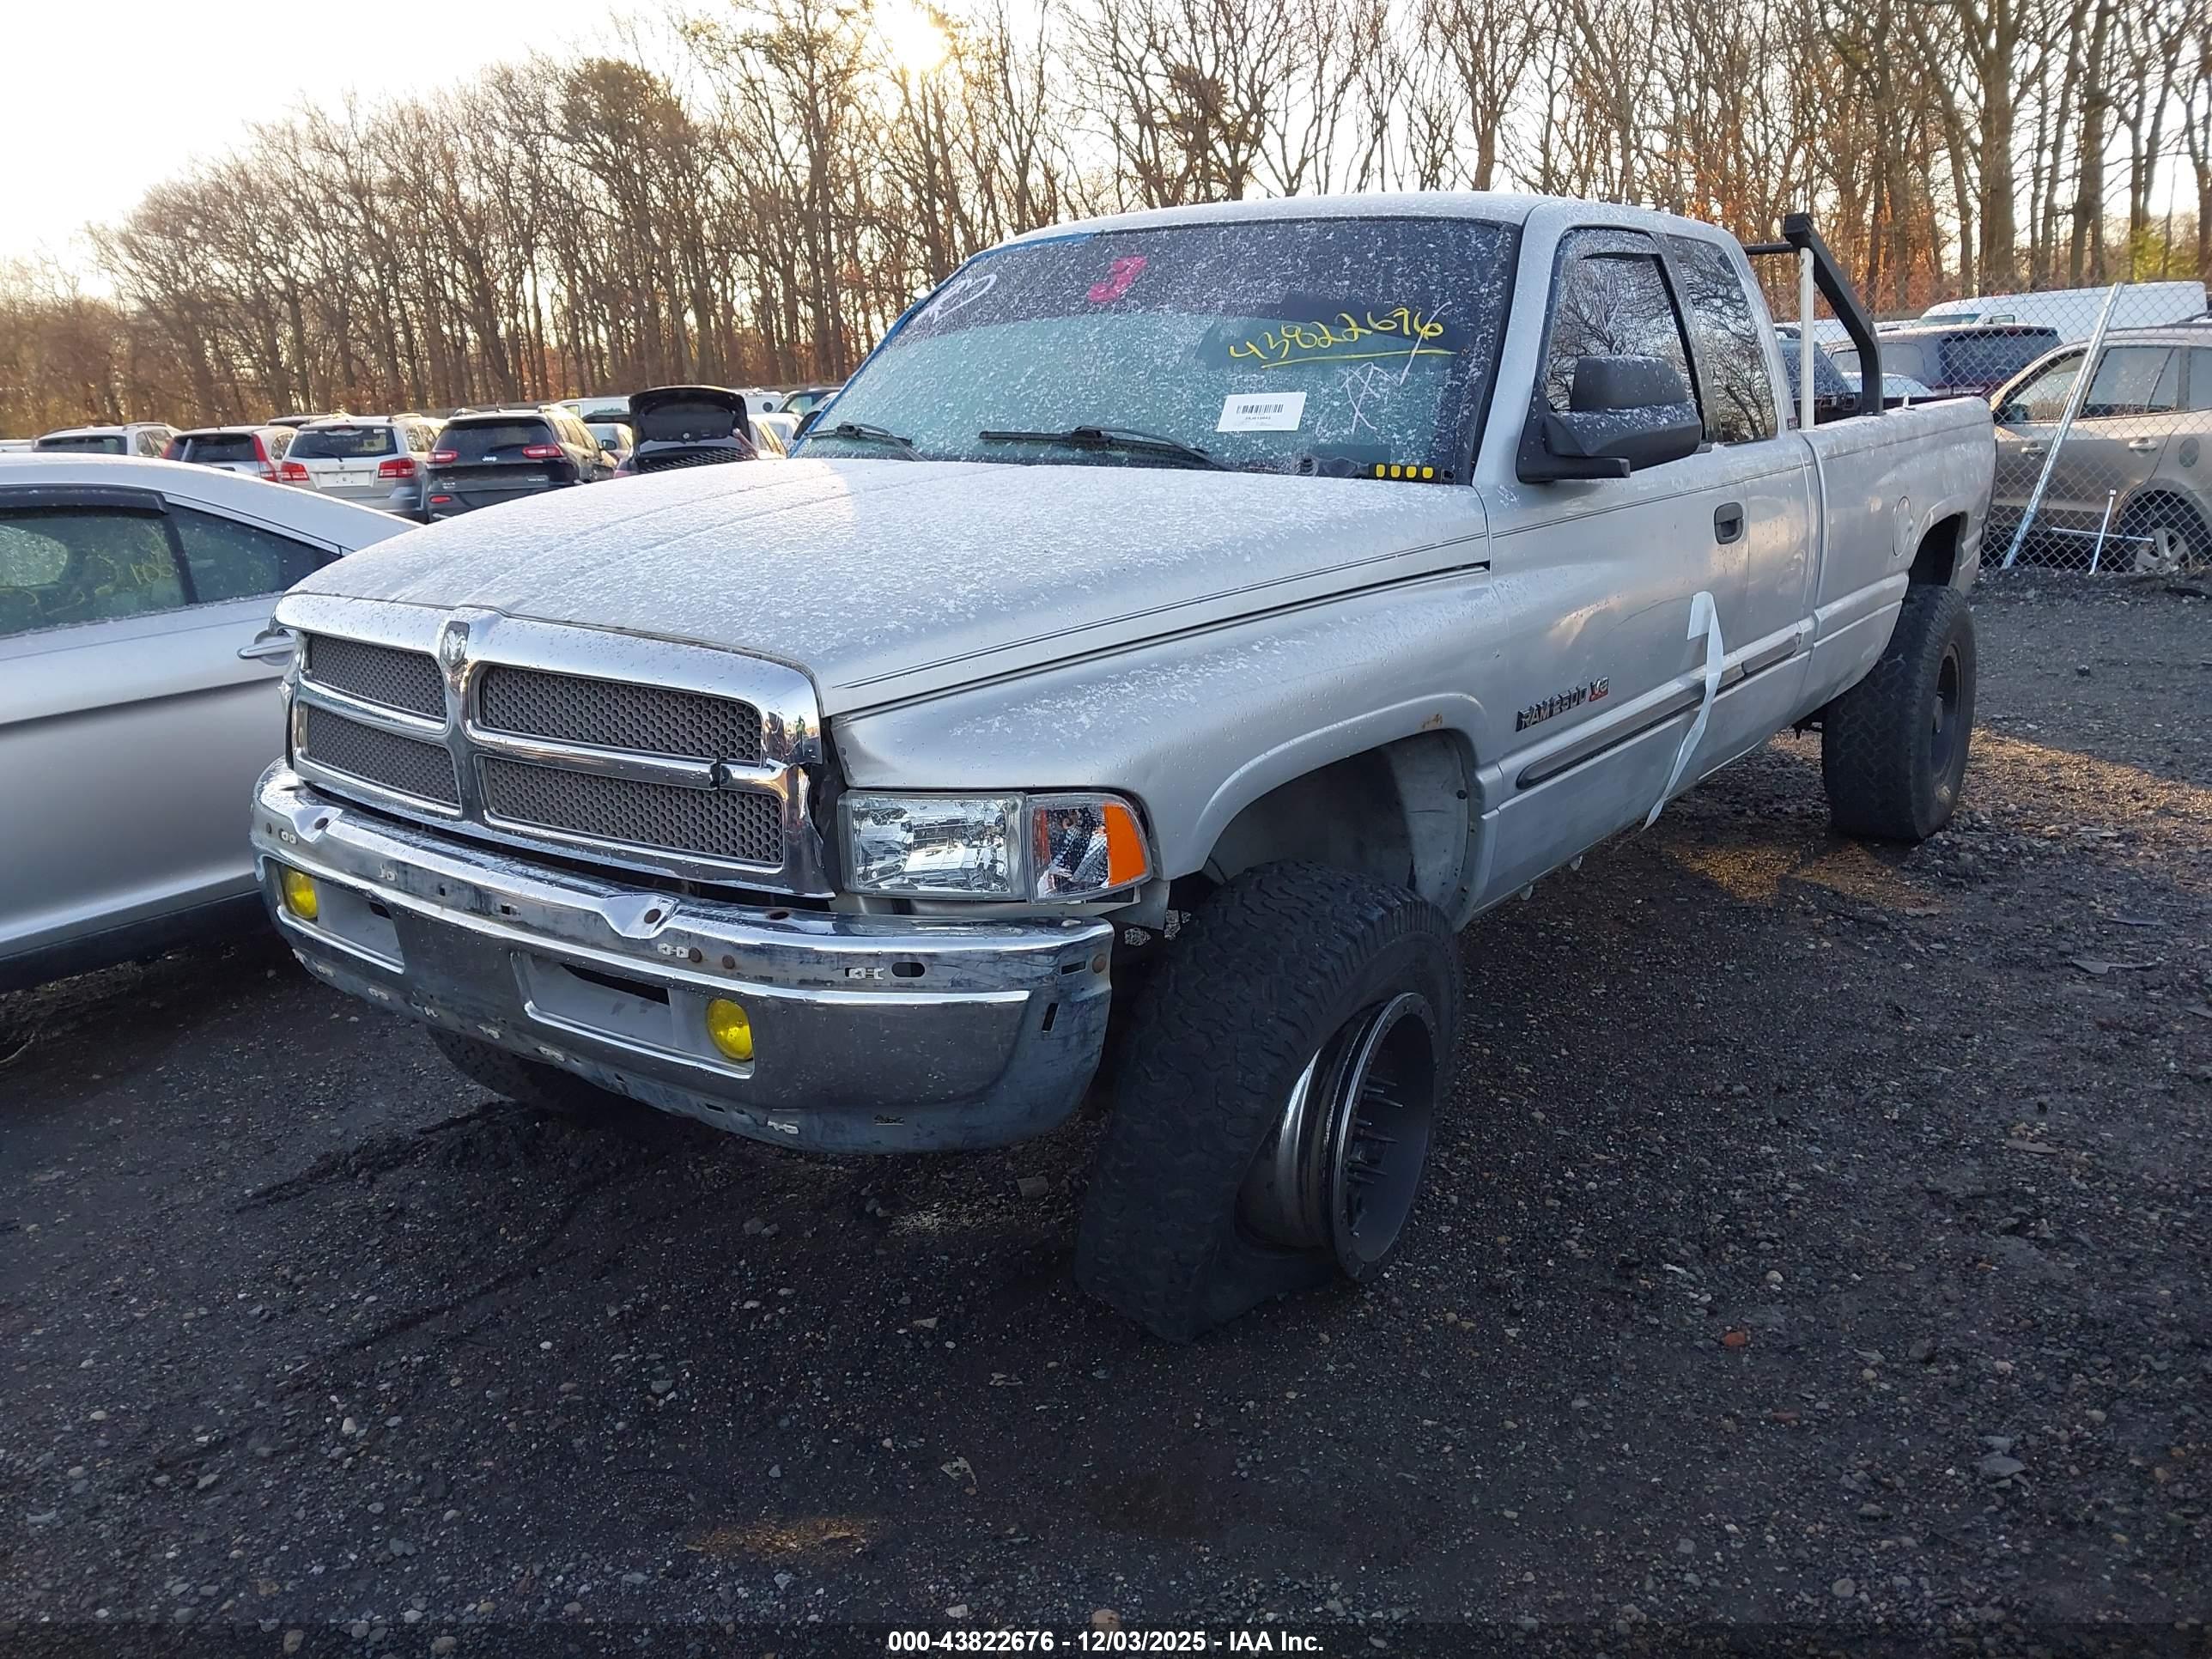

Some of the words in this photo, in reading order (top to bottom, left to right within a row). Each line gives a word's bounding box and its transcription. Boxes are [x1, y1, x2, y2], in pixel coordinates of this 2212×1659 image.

[1229, 307, 1444, 361] 43822676
[1516, 700, 1553, 732] RAM
[1552, 685, 1588, 717] 2500
